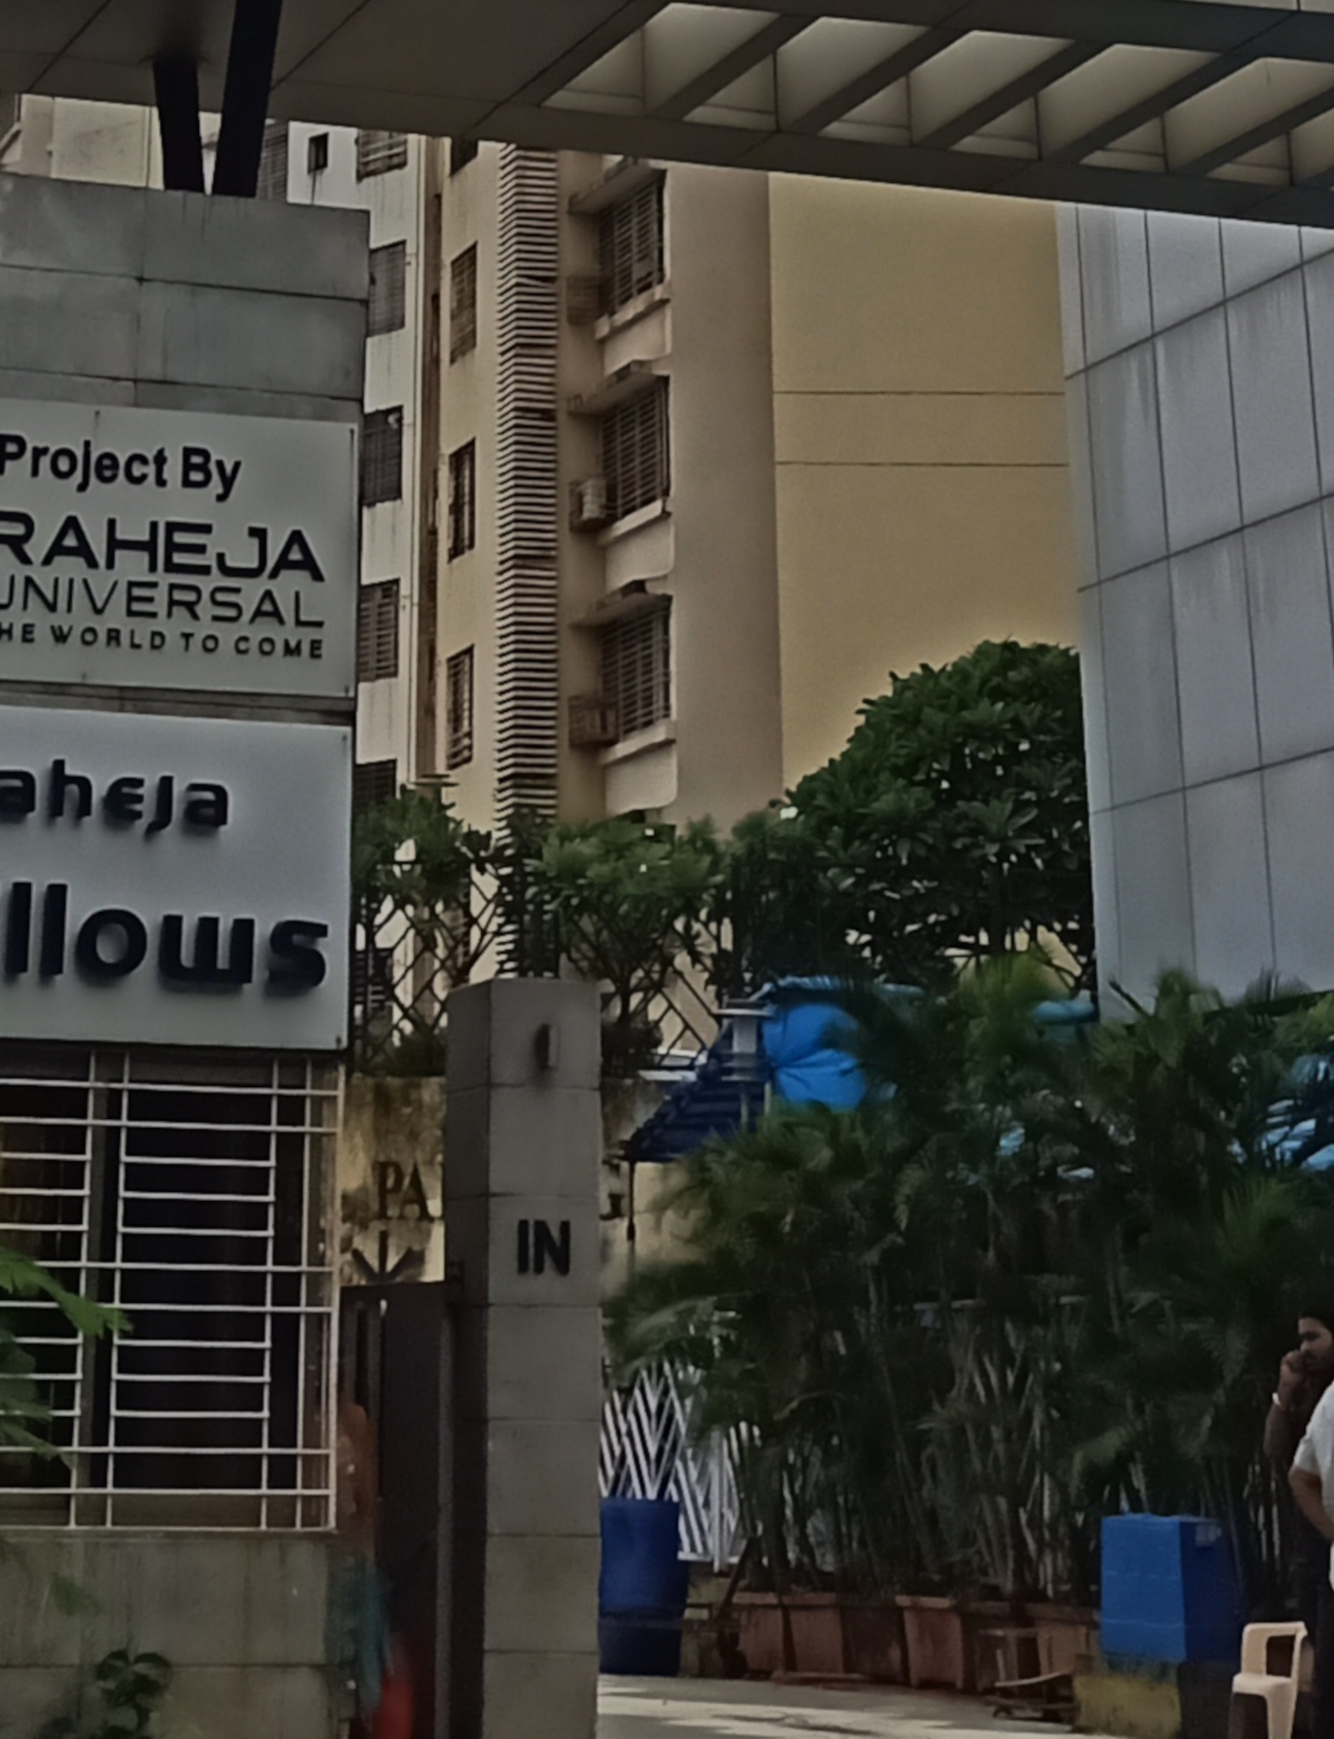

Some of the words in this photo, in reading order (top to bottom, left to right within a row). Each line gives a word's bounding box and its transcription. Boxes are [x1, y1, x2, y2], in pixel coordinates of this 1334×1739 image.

[181, 446, 243, 502] By
[50, 624, 166, 650] WORLD
[180, 632, 219, 653] TO
[234, 635, 323, 659] COME
[518, 1218, 571, 1275] IN
